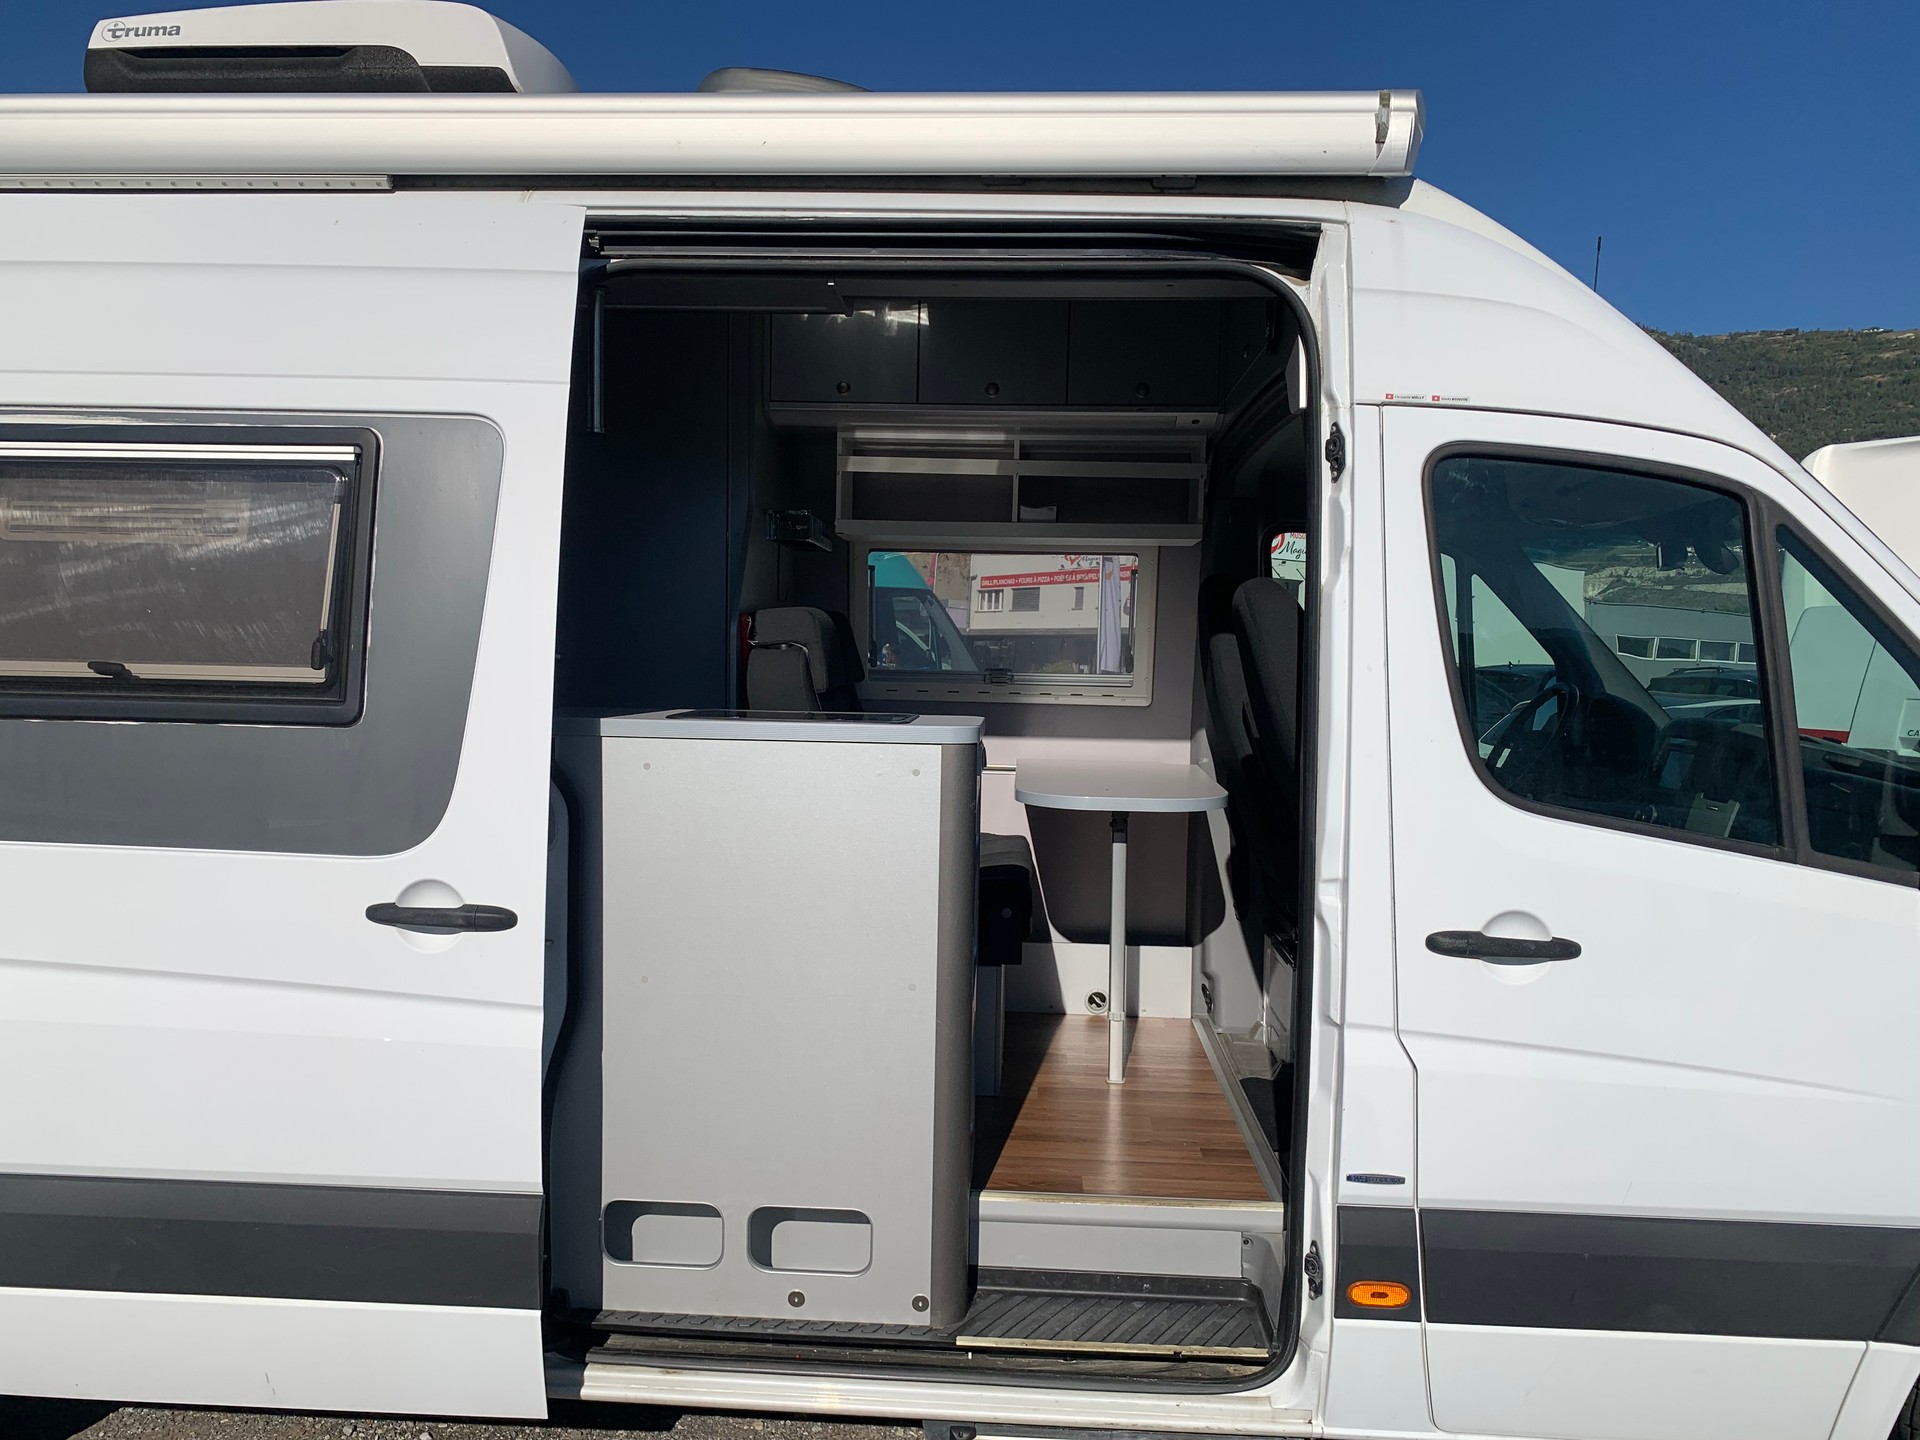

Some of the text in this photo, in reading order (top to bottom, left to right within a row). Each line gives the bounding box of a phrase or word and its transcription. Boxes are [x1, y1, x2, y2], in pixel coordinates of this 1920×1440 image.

[107, 22, 181, 39] truma
[1018, 576, 1034, 585] FOURS
[1037, 575, 1051, 584] PIZZA
